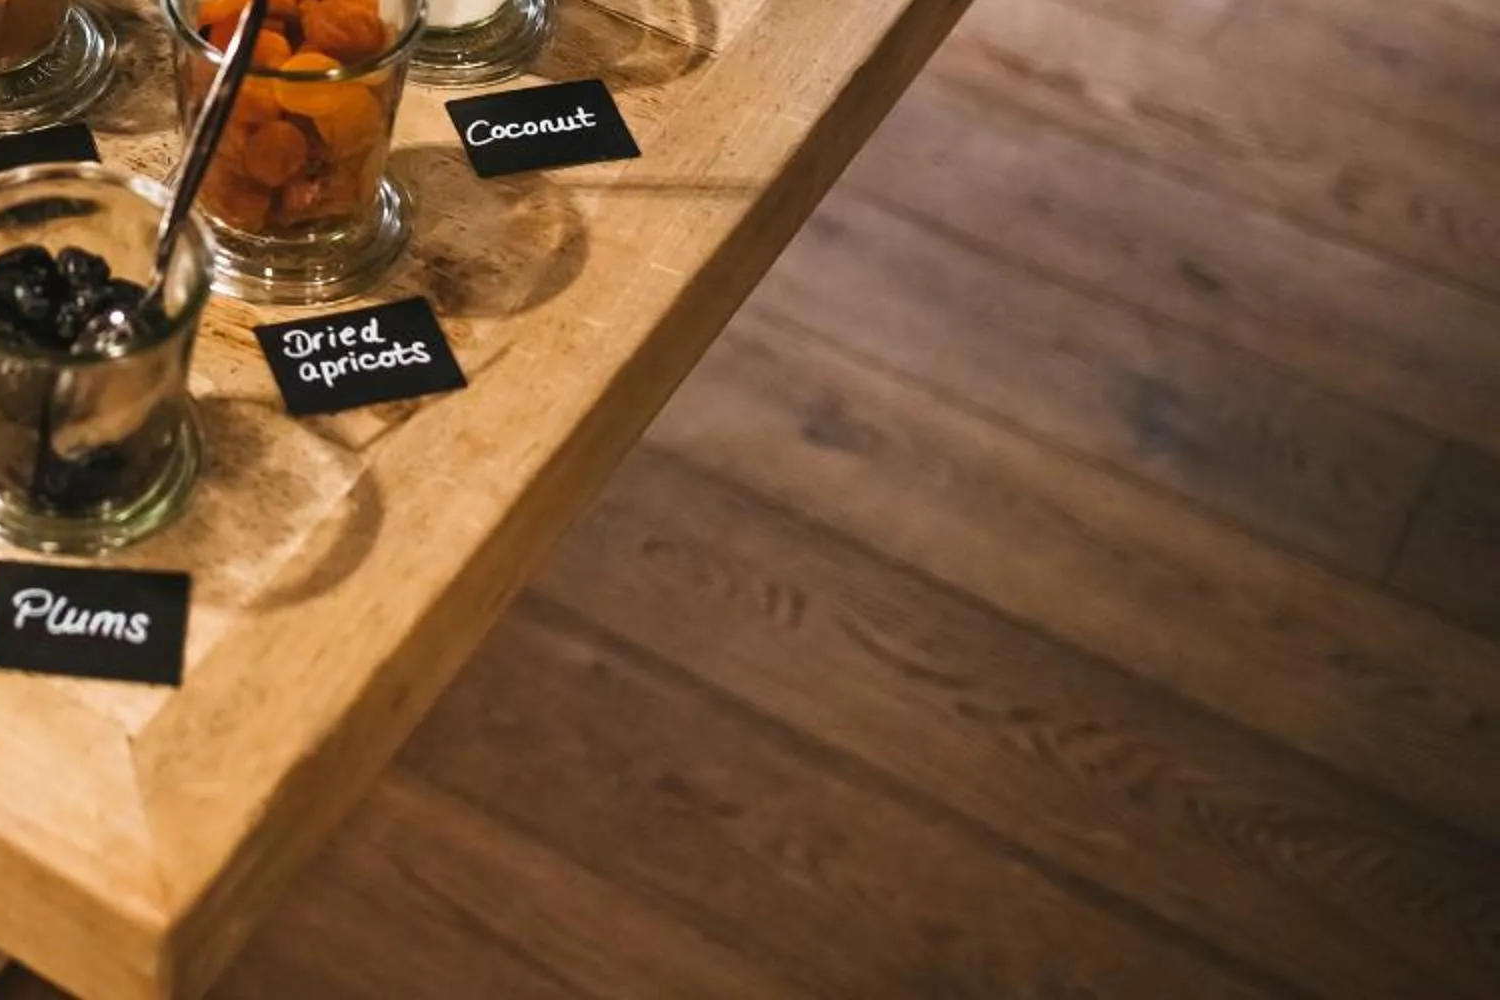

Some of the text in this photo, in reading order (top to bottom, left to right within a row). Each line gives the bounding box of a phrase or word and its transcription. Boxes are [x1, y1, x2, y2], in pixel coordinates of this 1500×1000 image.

[466, 106, 597, 146] Coconut
[283, 317, 386, 358] Dried
[299, 341, 431, 387] apricots
[12, 587, 150, 644] Plums
